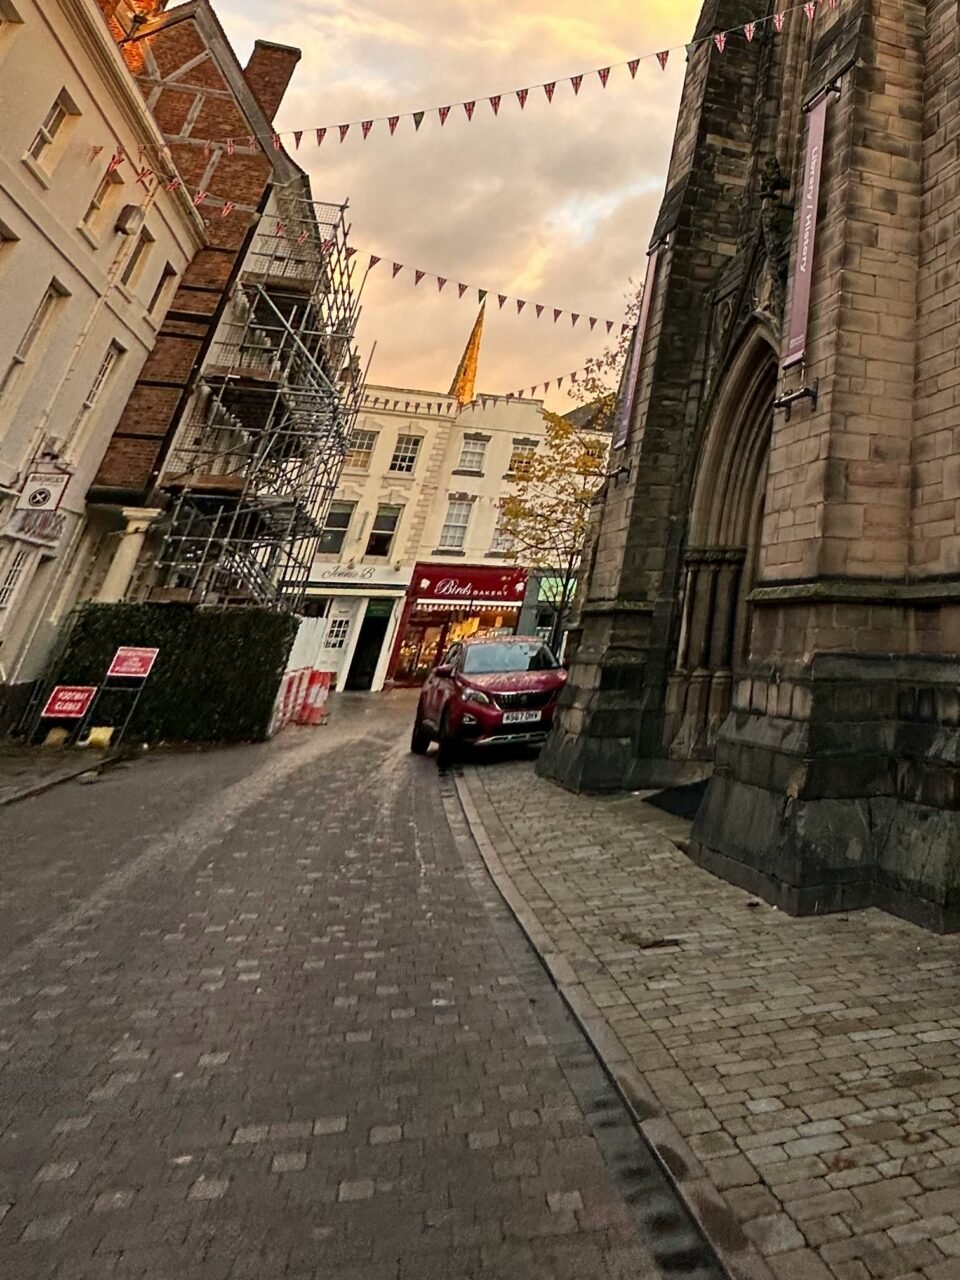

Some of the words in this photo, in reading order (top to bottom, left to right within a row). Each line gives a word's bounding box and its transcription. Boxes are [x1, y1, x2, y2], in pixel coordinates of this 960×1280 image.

[807, 146, 818, 200] Library
[800, 214, 812, 272] History
[361, 568, 376, 579] B
